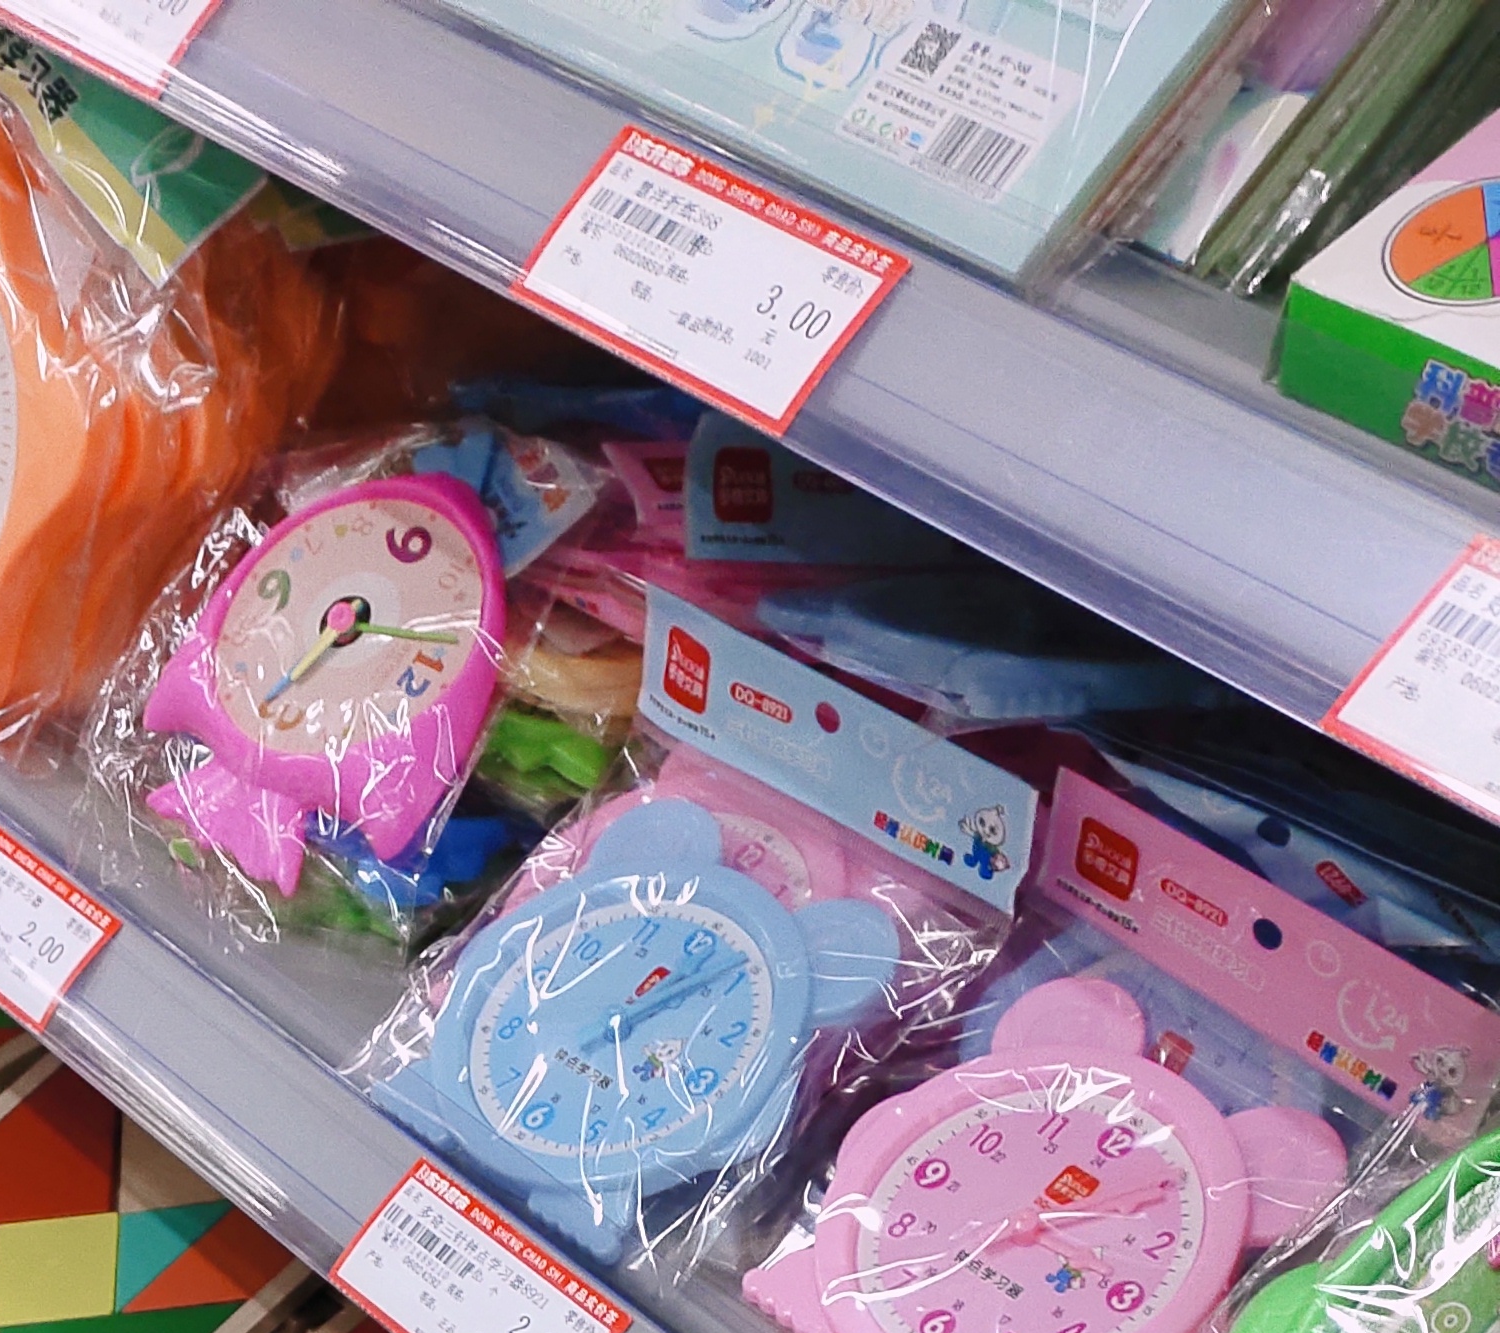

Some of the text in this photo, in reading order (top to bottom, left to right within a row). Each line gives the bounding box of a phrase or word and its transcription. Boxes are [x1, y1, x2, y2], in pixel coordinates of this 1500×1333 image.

[752, 282, 835, 343] 3.00
[17, 918, 67, 966] 2.00
[632, 917, 660, 948] 11
[573, 933, 601, 961] 10
[498, 1017, 523, 1039] 8
[719, 1021, 747, 1048] 2
[496, 1067, 521, 1089] 7
[522, 1106, 549, 1127] 6
[642, 1106, 667, 1129] 4
[1038, 1112, 1069, 1141] 11
[586, 1120, 608, 1142] 5
[969, 1124, 1003, 1155] 10
[1102, 1130, 1133, 1158] 12
[919, 1161, 947, 1186] 9
[888, 1213, 916, 1238] 8
[468, 1206, 496, 1232] DONG
[491, 1224, 524, 1253] SHENG
[518, 1245, 548, 1272] CHAO
[543, 1265, 565, 1285] SHI
[1143, 1232, 1175, 1260] 2
[1110, 1286, 1140, 1310] 3
